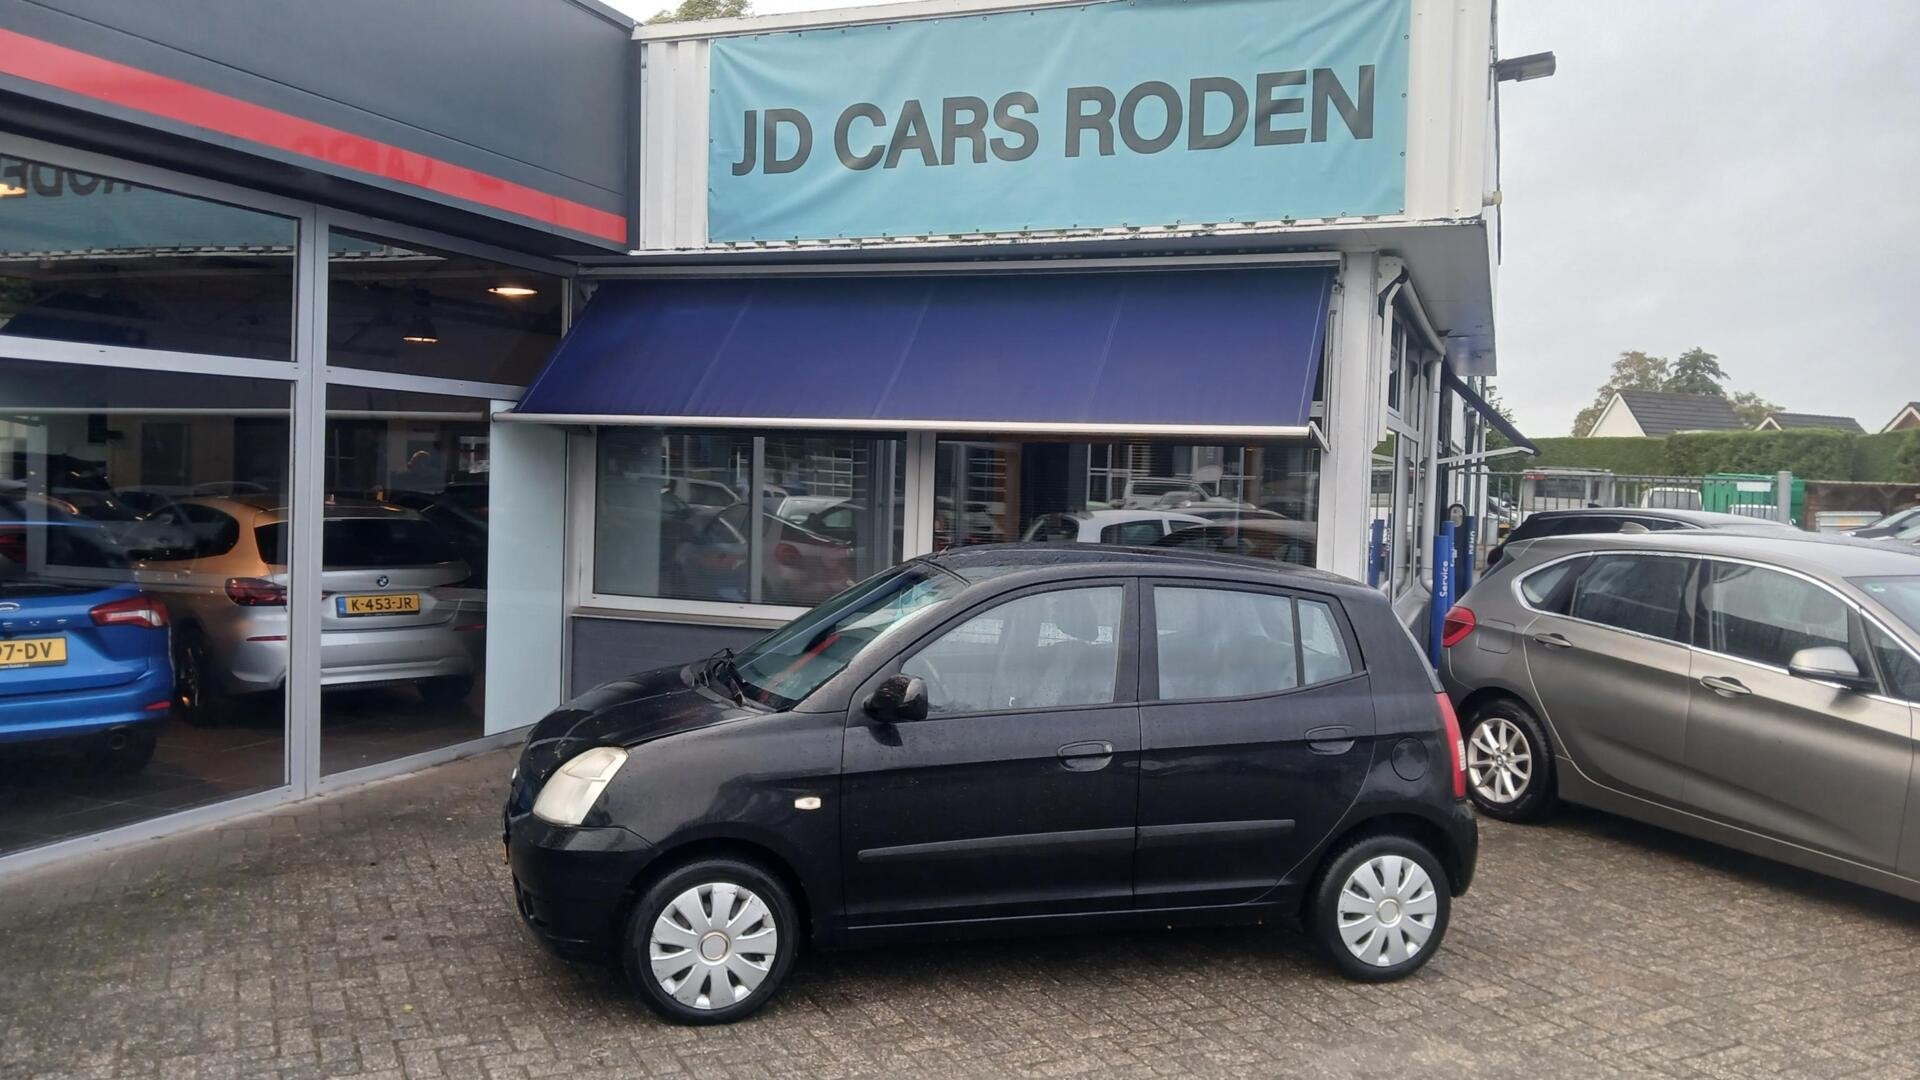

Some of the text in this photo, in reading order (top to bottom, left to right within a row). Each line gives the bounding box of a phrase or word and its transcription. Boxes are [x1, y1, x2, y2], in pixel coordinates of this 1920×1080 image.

[731, 64, 1375, 176] JD CARS RODEN
[1439, 560, 1449, 598] Service
[351, 597, 413, 612] K-453-JR
[0, 642, 52, 661] 7-DV
